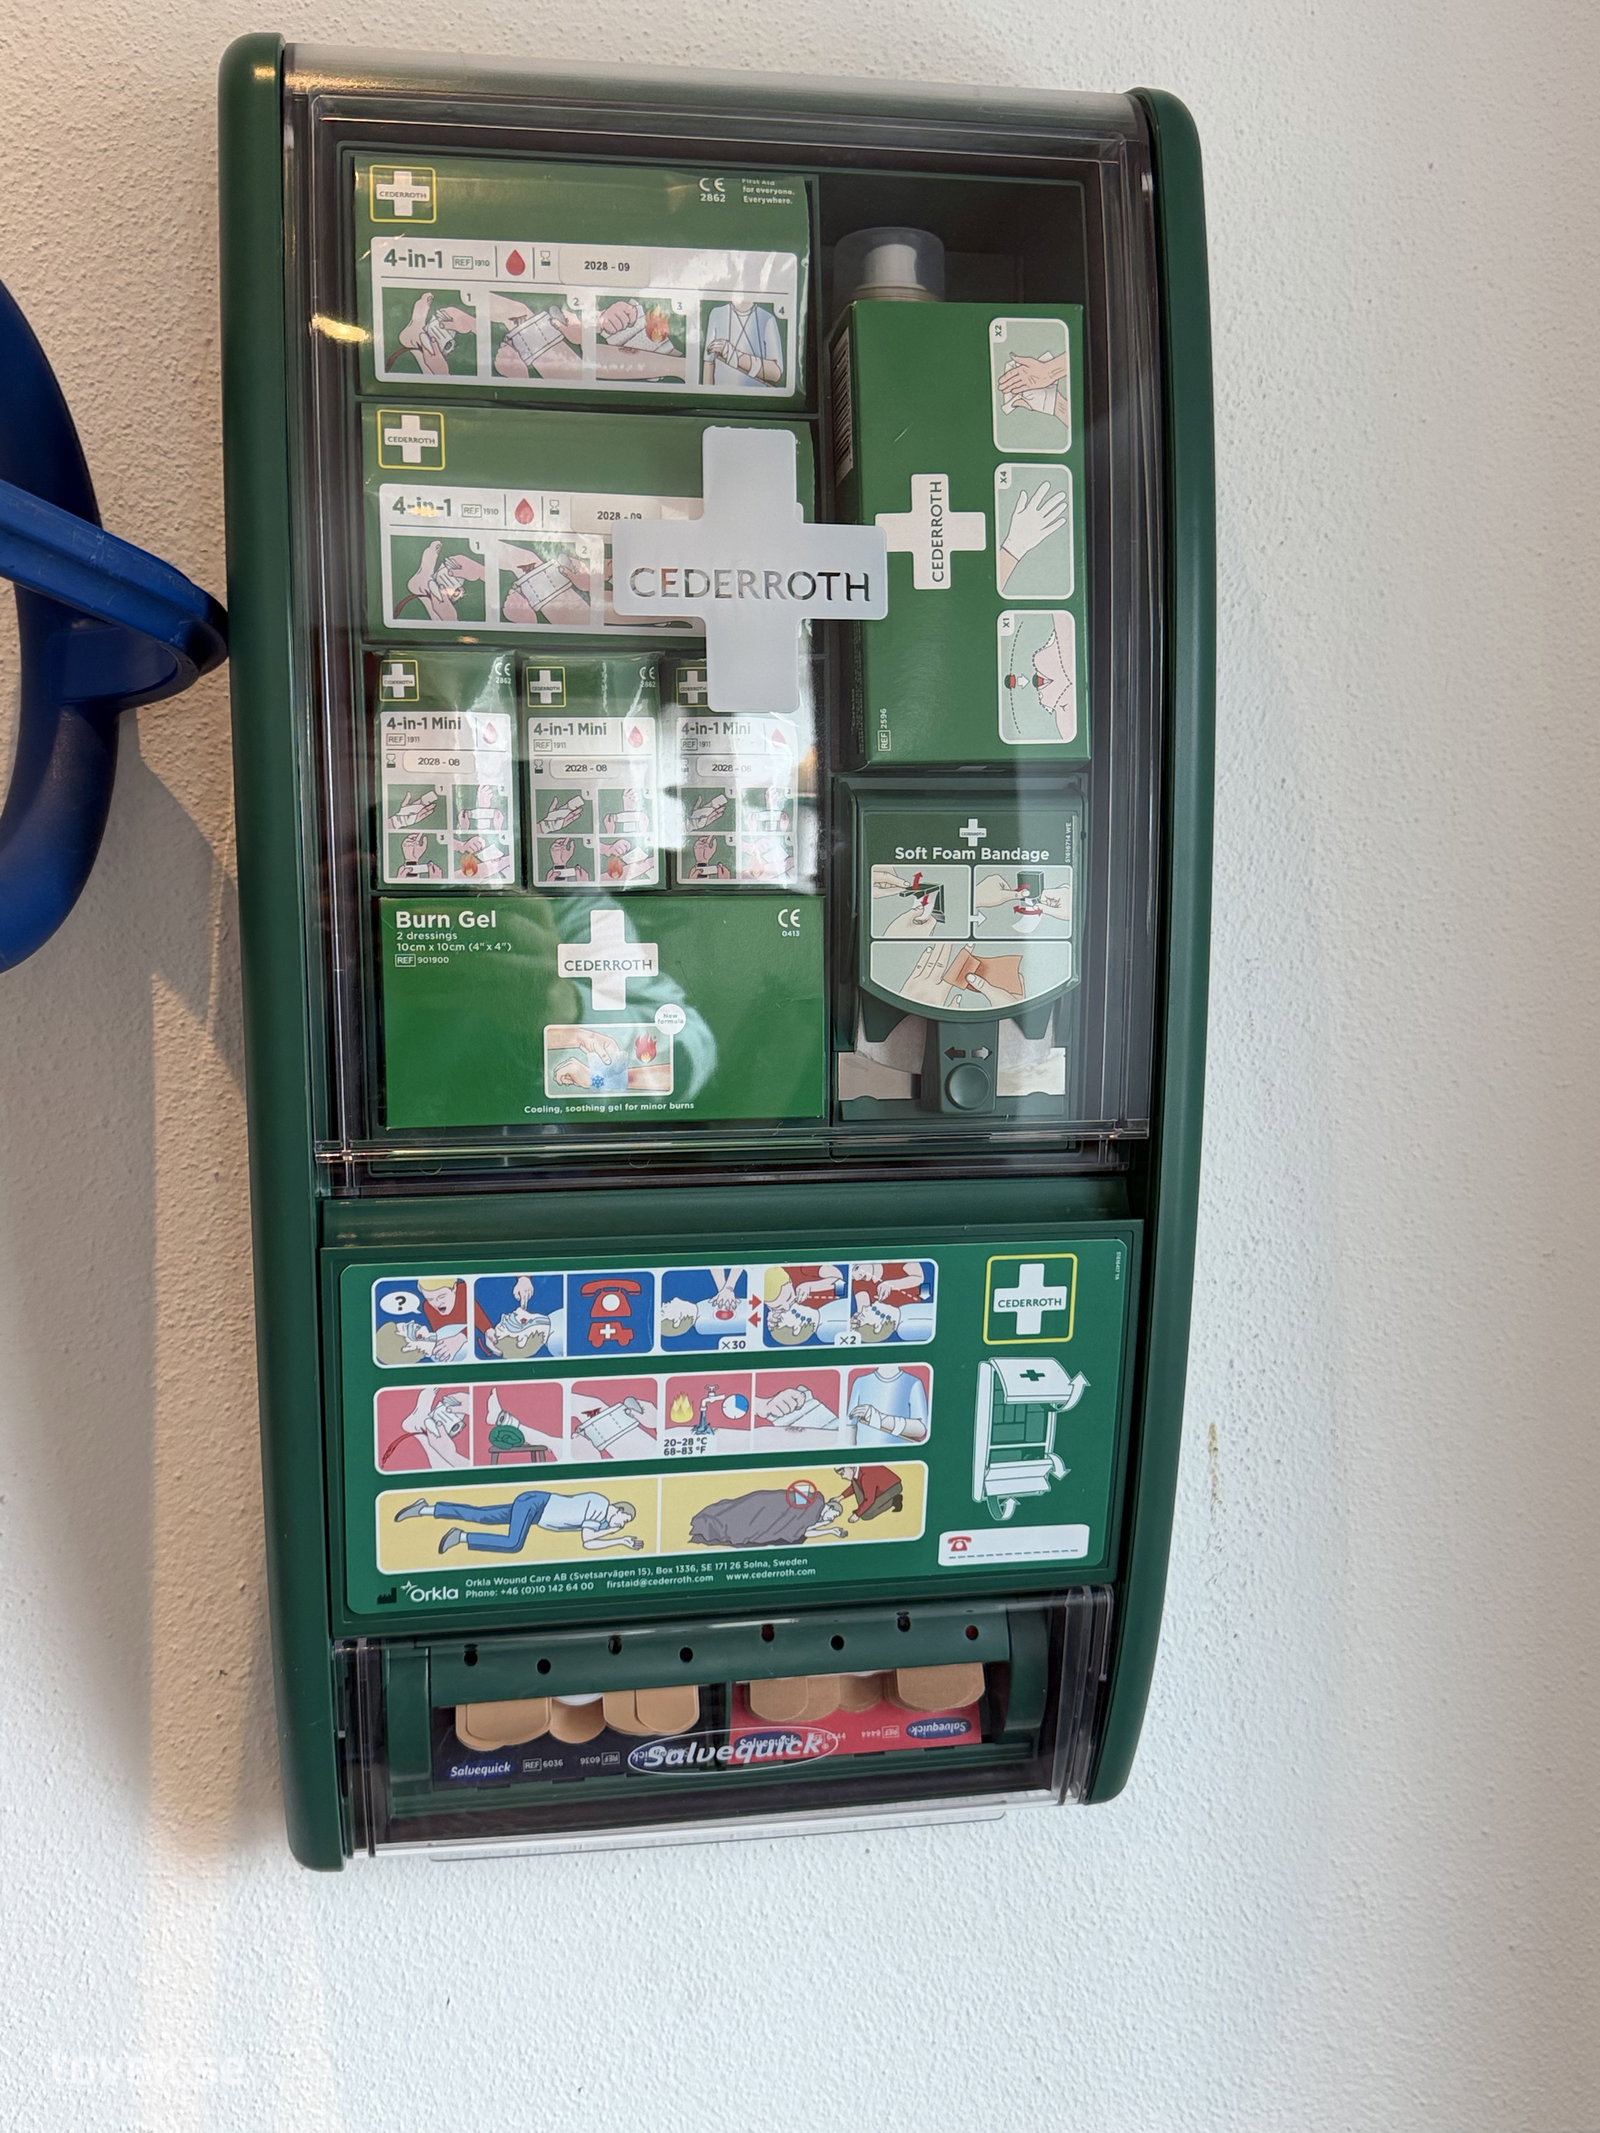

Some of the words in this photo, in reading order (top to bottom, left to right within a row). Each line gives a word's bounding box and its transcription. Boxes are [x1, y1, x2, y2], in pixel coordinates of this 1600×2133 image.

[379, 191, 427, 199] CEDERROTH
[743, 186, 754, 194] for
[700, 193, 726, 203] 2862
[743, 195, 793, 205] Everywhere.
[383, 248, 443, 270] 4-in-1
[455, 257, 472, 268] REF
[474, 258, 490, 268] 1910
[584, 260, 608, 271] 2028
[618, 262, 630, 272] 09
[387, 435, 436, 444] CEDERROTH
[392, 497, 452, 516] 4-in-1
[463, 506, 481, 516] REF
[483, 507, 499, 516] 1910
[596, 510, 620, 521] 2028
[930, 481, 944, 582] CEDERROTH
[630, 567, 870, 601] CEDERROTH
[386, 717, 427, 730] 4-in-1
[432, 717, 461, 730] Mini
[880, 708, 888, 729] 2596
[534, 723, 574, 736] 4-in-1
[578, 723, 607, 736] Mini
[681, 722, 719, 735] 4-in-1
[723, 722, 751, 735] Mini
[418, 757, 440, 766] 2028
[712, 764, 733, 772] 2028
[565, 764, 587, 773] 2028
[895, 847, 927, 860] Soft
[933, 848, 976, 860] Foam
[981, 848, 1049, 862] Bandage
[395, 911, 450, 929] Burn
[458, 910, 497, 928] Gel
[407, 931, 458, 941] dressings
[397, 943, 425, 951] 10cm
[436, 943, 465, 951] 10cm
[398, 956, 414, 965] REF
[417, 956, 449, 964] 901900
[564, 959, 653, 972] CEDERROTH
[524, 1105, 563, 1115] Cooling,
[566, 1104, 606, 1114] soothing
[608, 1104, 622, 1114] gel
[625, 1103, 638, 1111] for
[641, 1102, 667, 1111] minor
[669, 1102, 694, 1110] burns
[998, 1298, 1062, 1308] CEDERROTH
[465, 1578, 491, 1587] Orkla
[494, 1577, 527, 1586] Wound
[529, 1575, 551, 1583] Care
[553, 1573, 567, 1581] AB
[637, 1567, 653, 1577] 15),
[656, 1566, 673, 1575] Box
[676, 1564, 698, 1574] 1336,
[701, 1563, 712, 1572] SE
[715, 1562, 728, 1570] 171
[729, 1561, 741, 1569] 26
[743, 1560, 771, 1569] Solna,
[773, 1558, 808, 1567] Sweden
[466, 1588, 498, 1598] Phone:
[500, 1587, 518, 1596] +46
[521, 1585, 546, 1596] (0)10
[548, 1584, 564, 1592] 142
[566, 1583, 578, 1591] 64
[580, 1582, 594, 1590] 00
[606, 1574, 714, 1589] firstaid@cederroth.com
[726, 1567, 816, 1582] www.cederroth.com
[411, 1585, 458, 1602] Orkla
[912, 1722, 967, 1737] Salvequick
[644, 1733, 822, 1767] Salvequick
[451, 1761, 511, 1777] Salvequick
[543, 1759, 563, 1768] 6036
